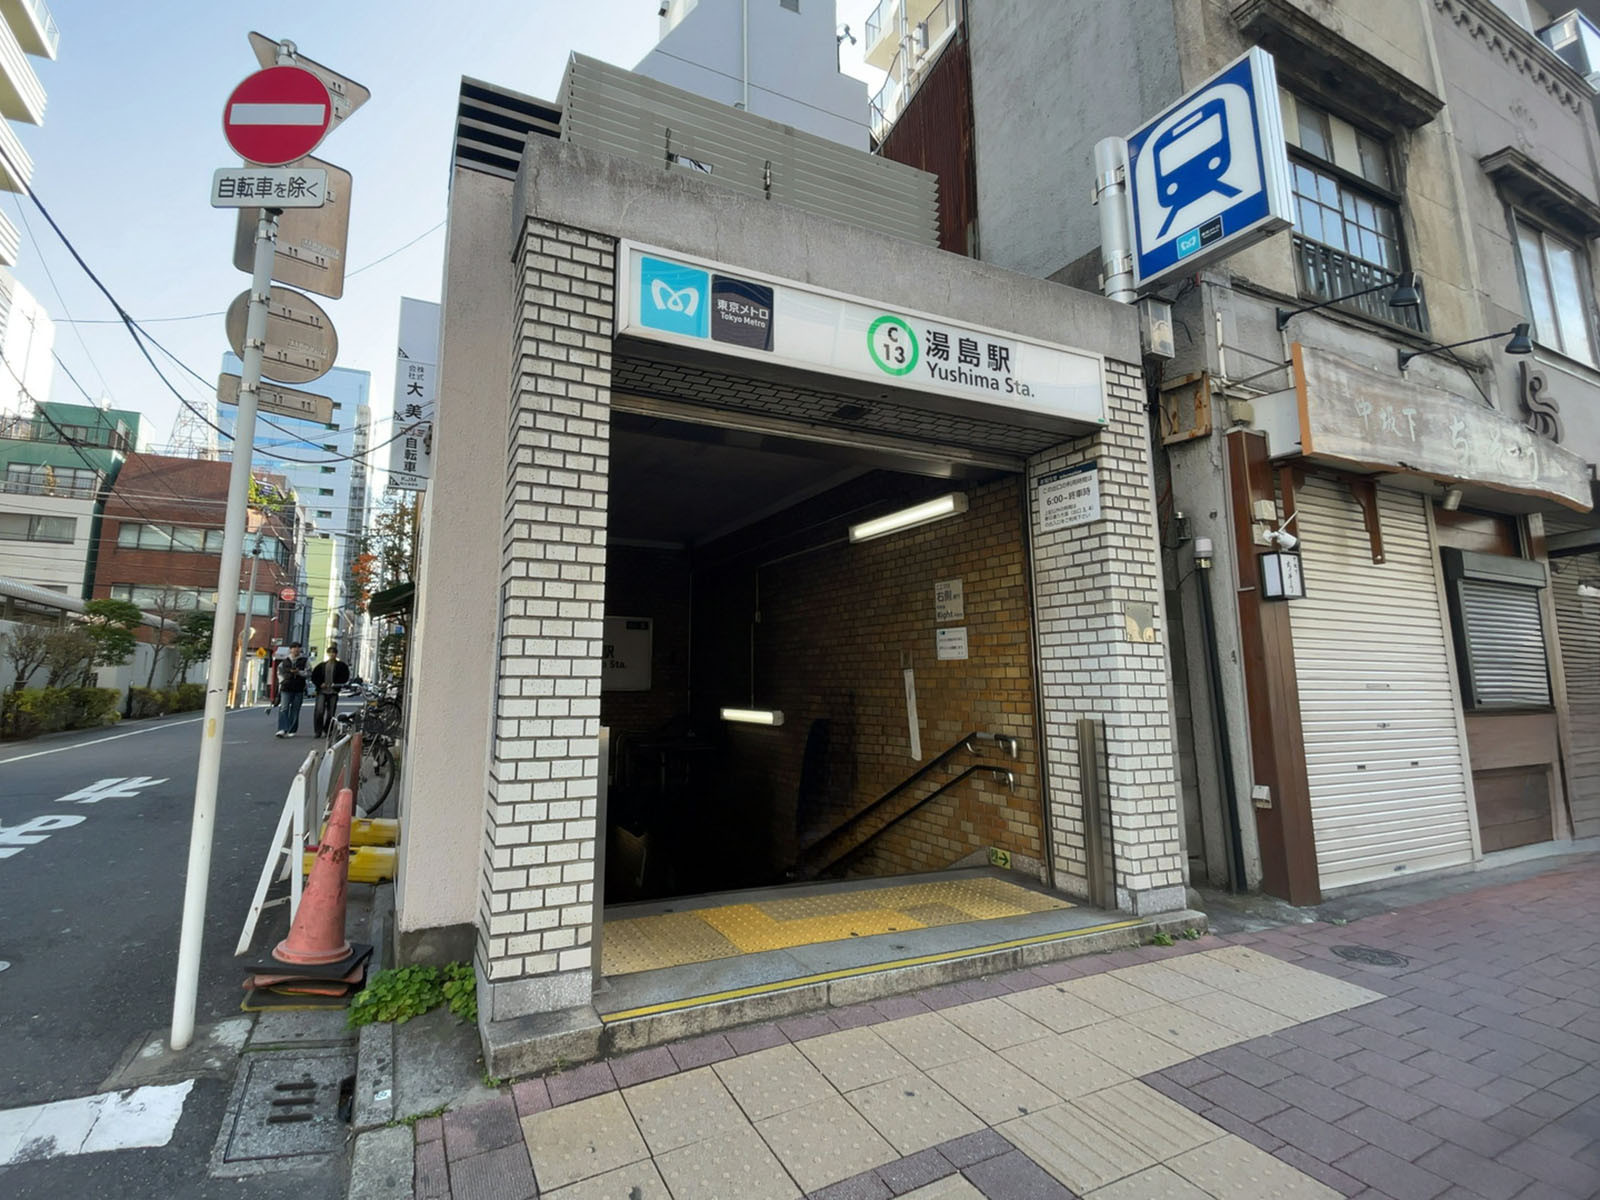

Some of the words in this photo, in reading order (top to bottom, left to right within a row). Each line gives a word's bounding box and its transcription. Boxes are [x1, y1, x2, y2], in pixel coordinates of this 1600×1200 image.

[218, 176, 319, 198] 自転車を除く
[717, 299, 769, 320] 東京メトロ
[720, 311, 742, 324] Tokyo
[743, 317, 766, 328] Metro
[887, 326, 898, 343] C
[883, 344, 906, 364] 13
[925, 329, 1011, 374] 湯島駅
[926, 361, 999, 391] Yushima
[1005, 377, 1035, 397] Sta.
